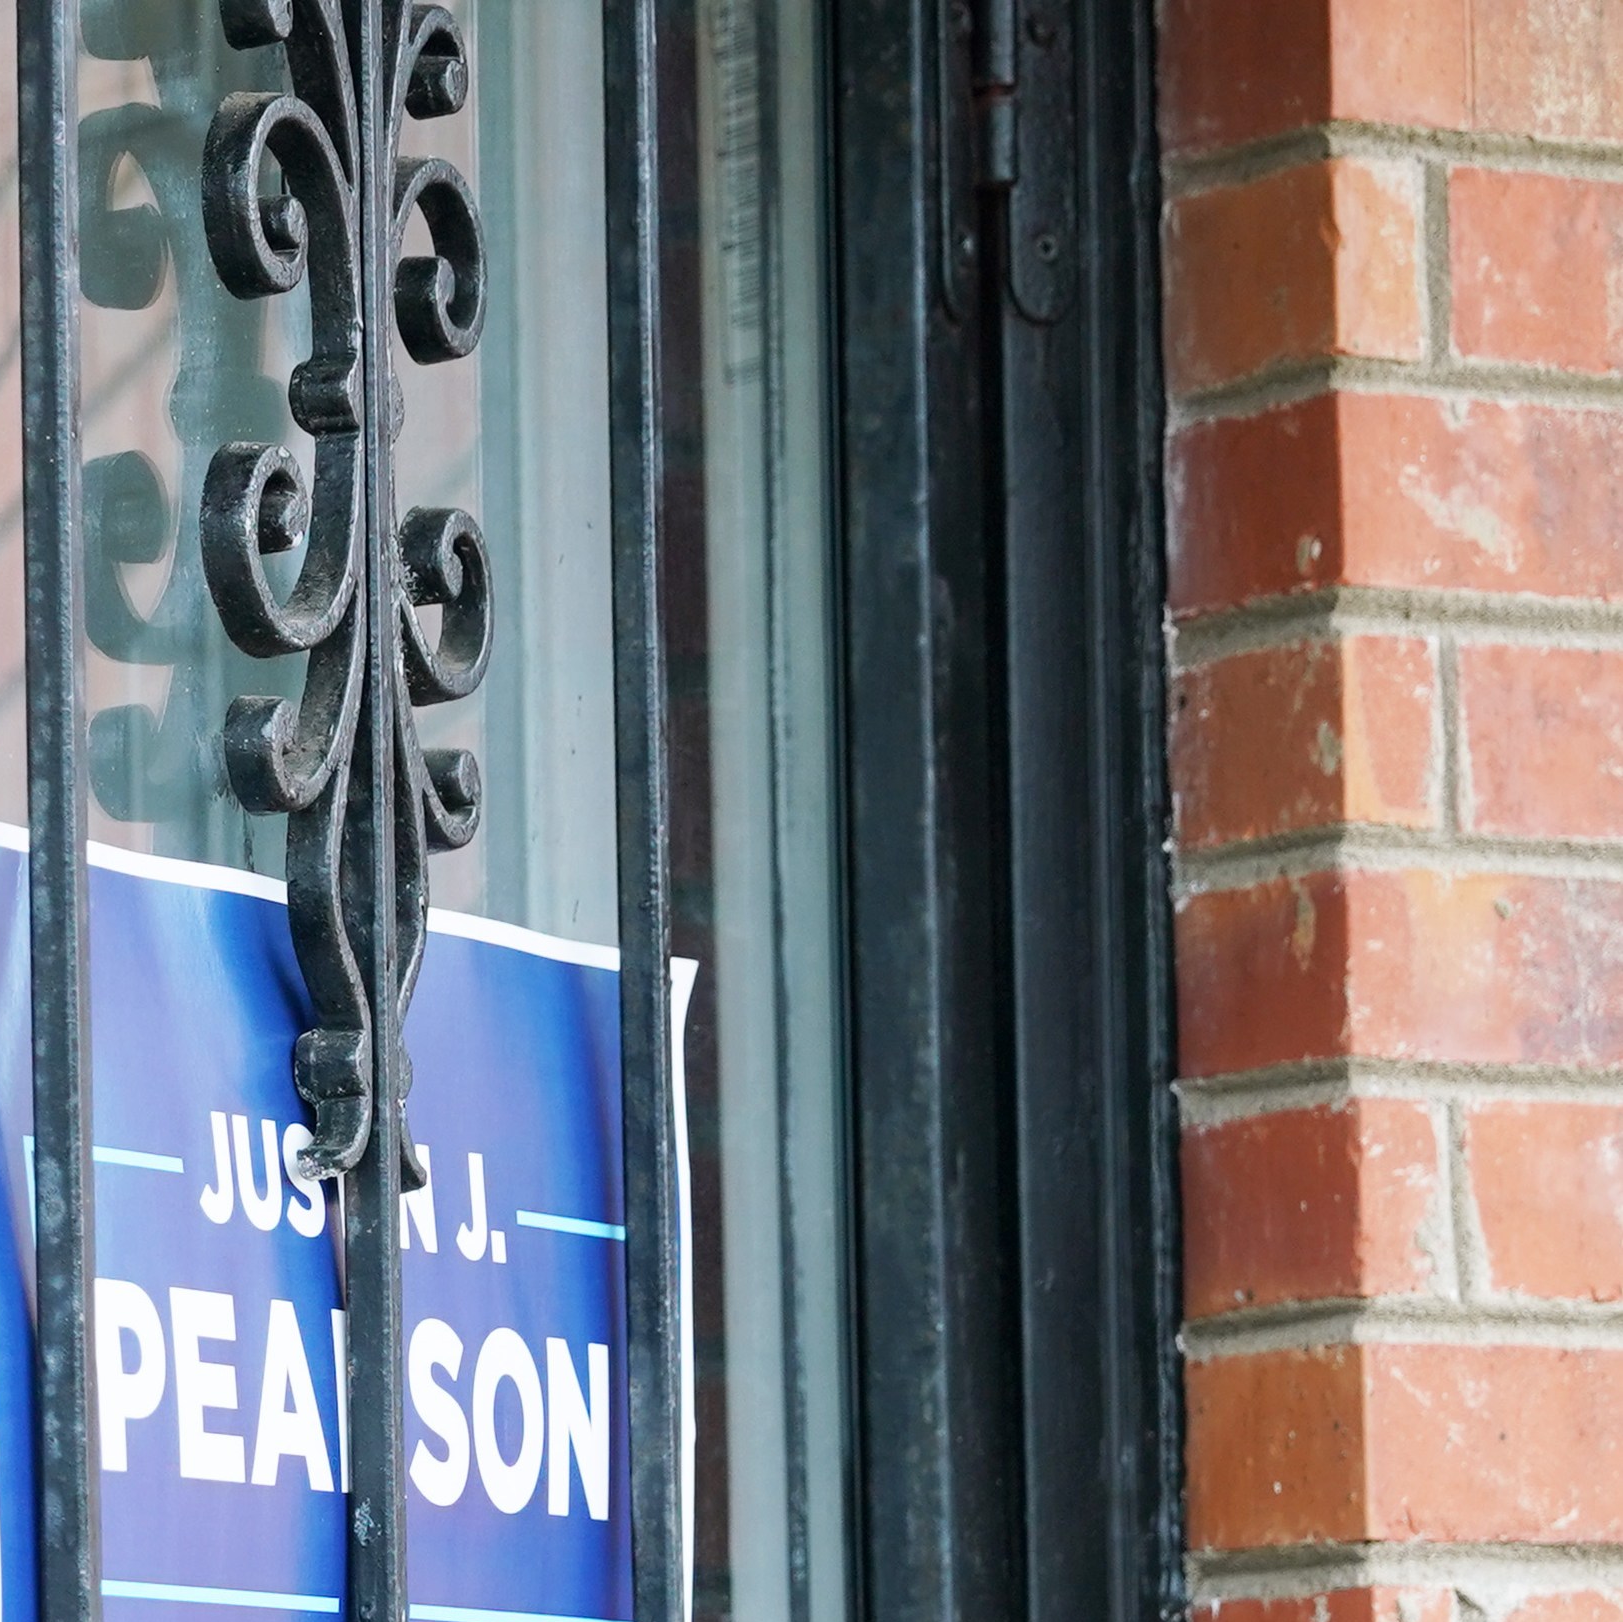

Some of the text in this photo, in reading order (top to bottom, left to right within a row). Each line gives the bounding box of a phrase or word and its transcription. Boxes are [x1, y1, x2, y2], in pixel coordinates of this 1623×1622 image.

[199, 1110, 507, 1265] JUSN J.
[95, 1277, 610, 1521] PEASON
